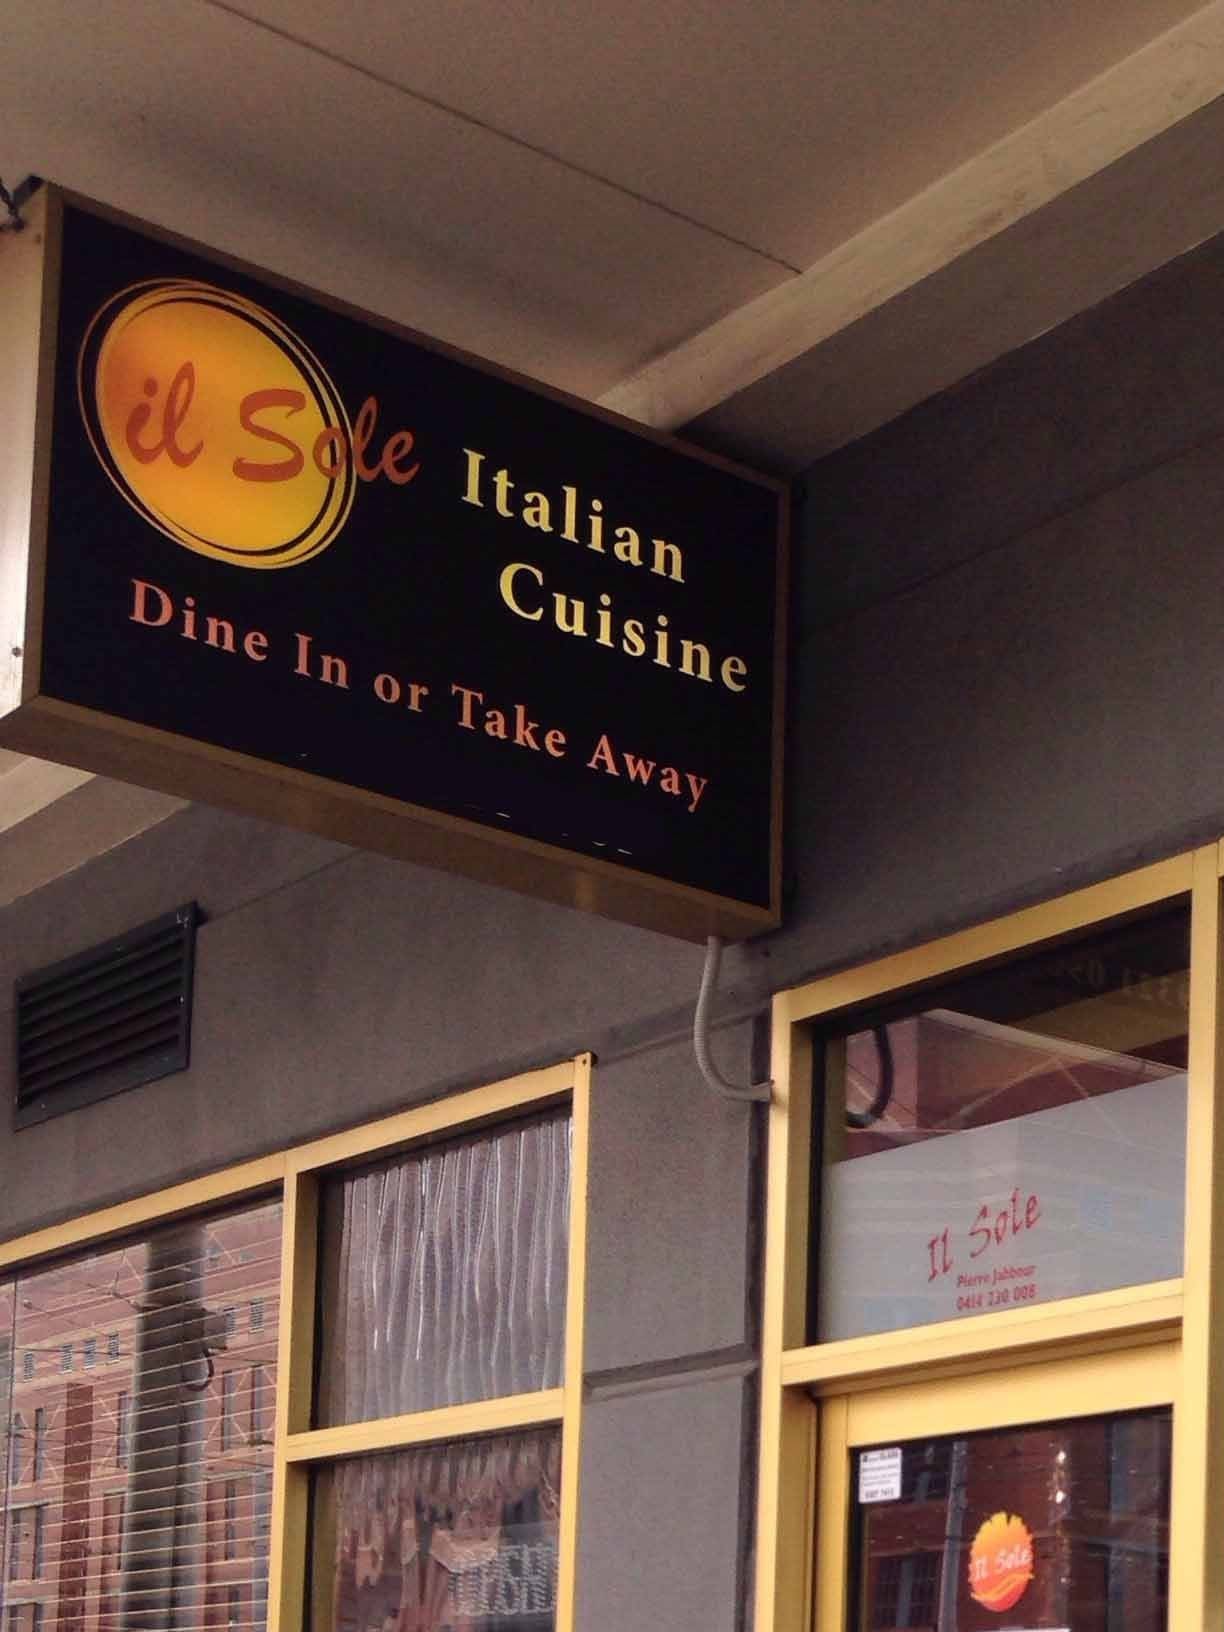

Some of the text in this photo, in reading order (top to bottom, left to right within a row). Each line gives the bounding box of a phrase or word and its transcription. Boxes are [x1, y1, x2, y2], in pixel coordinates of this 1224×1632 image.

[125, 361, 421, 483] il Sole
[462, 448, 686, 584] Italian
[499, 562, 749, 693] Cuisine
[129, 578, 709, 813] Dine In or Take Away
[968, 1187, 1042, 1259] Sole
